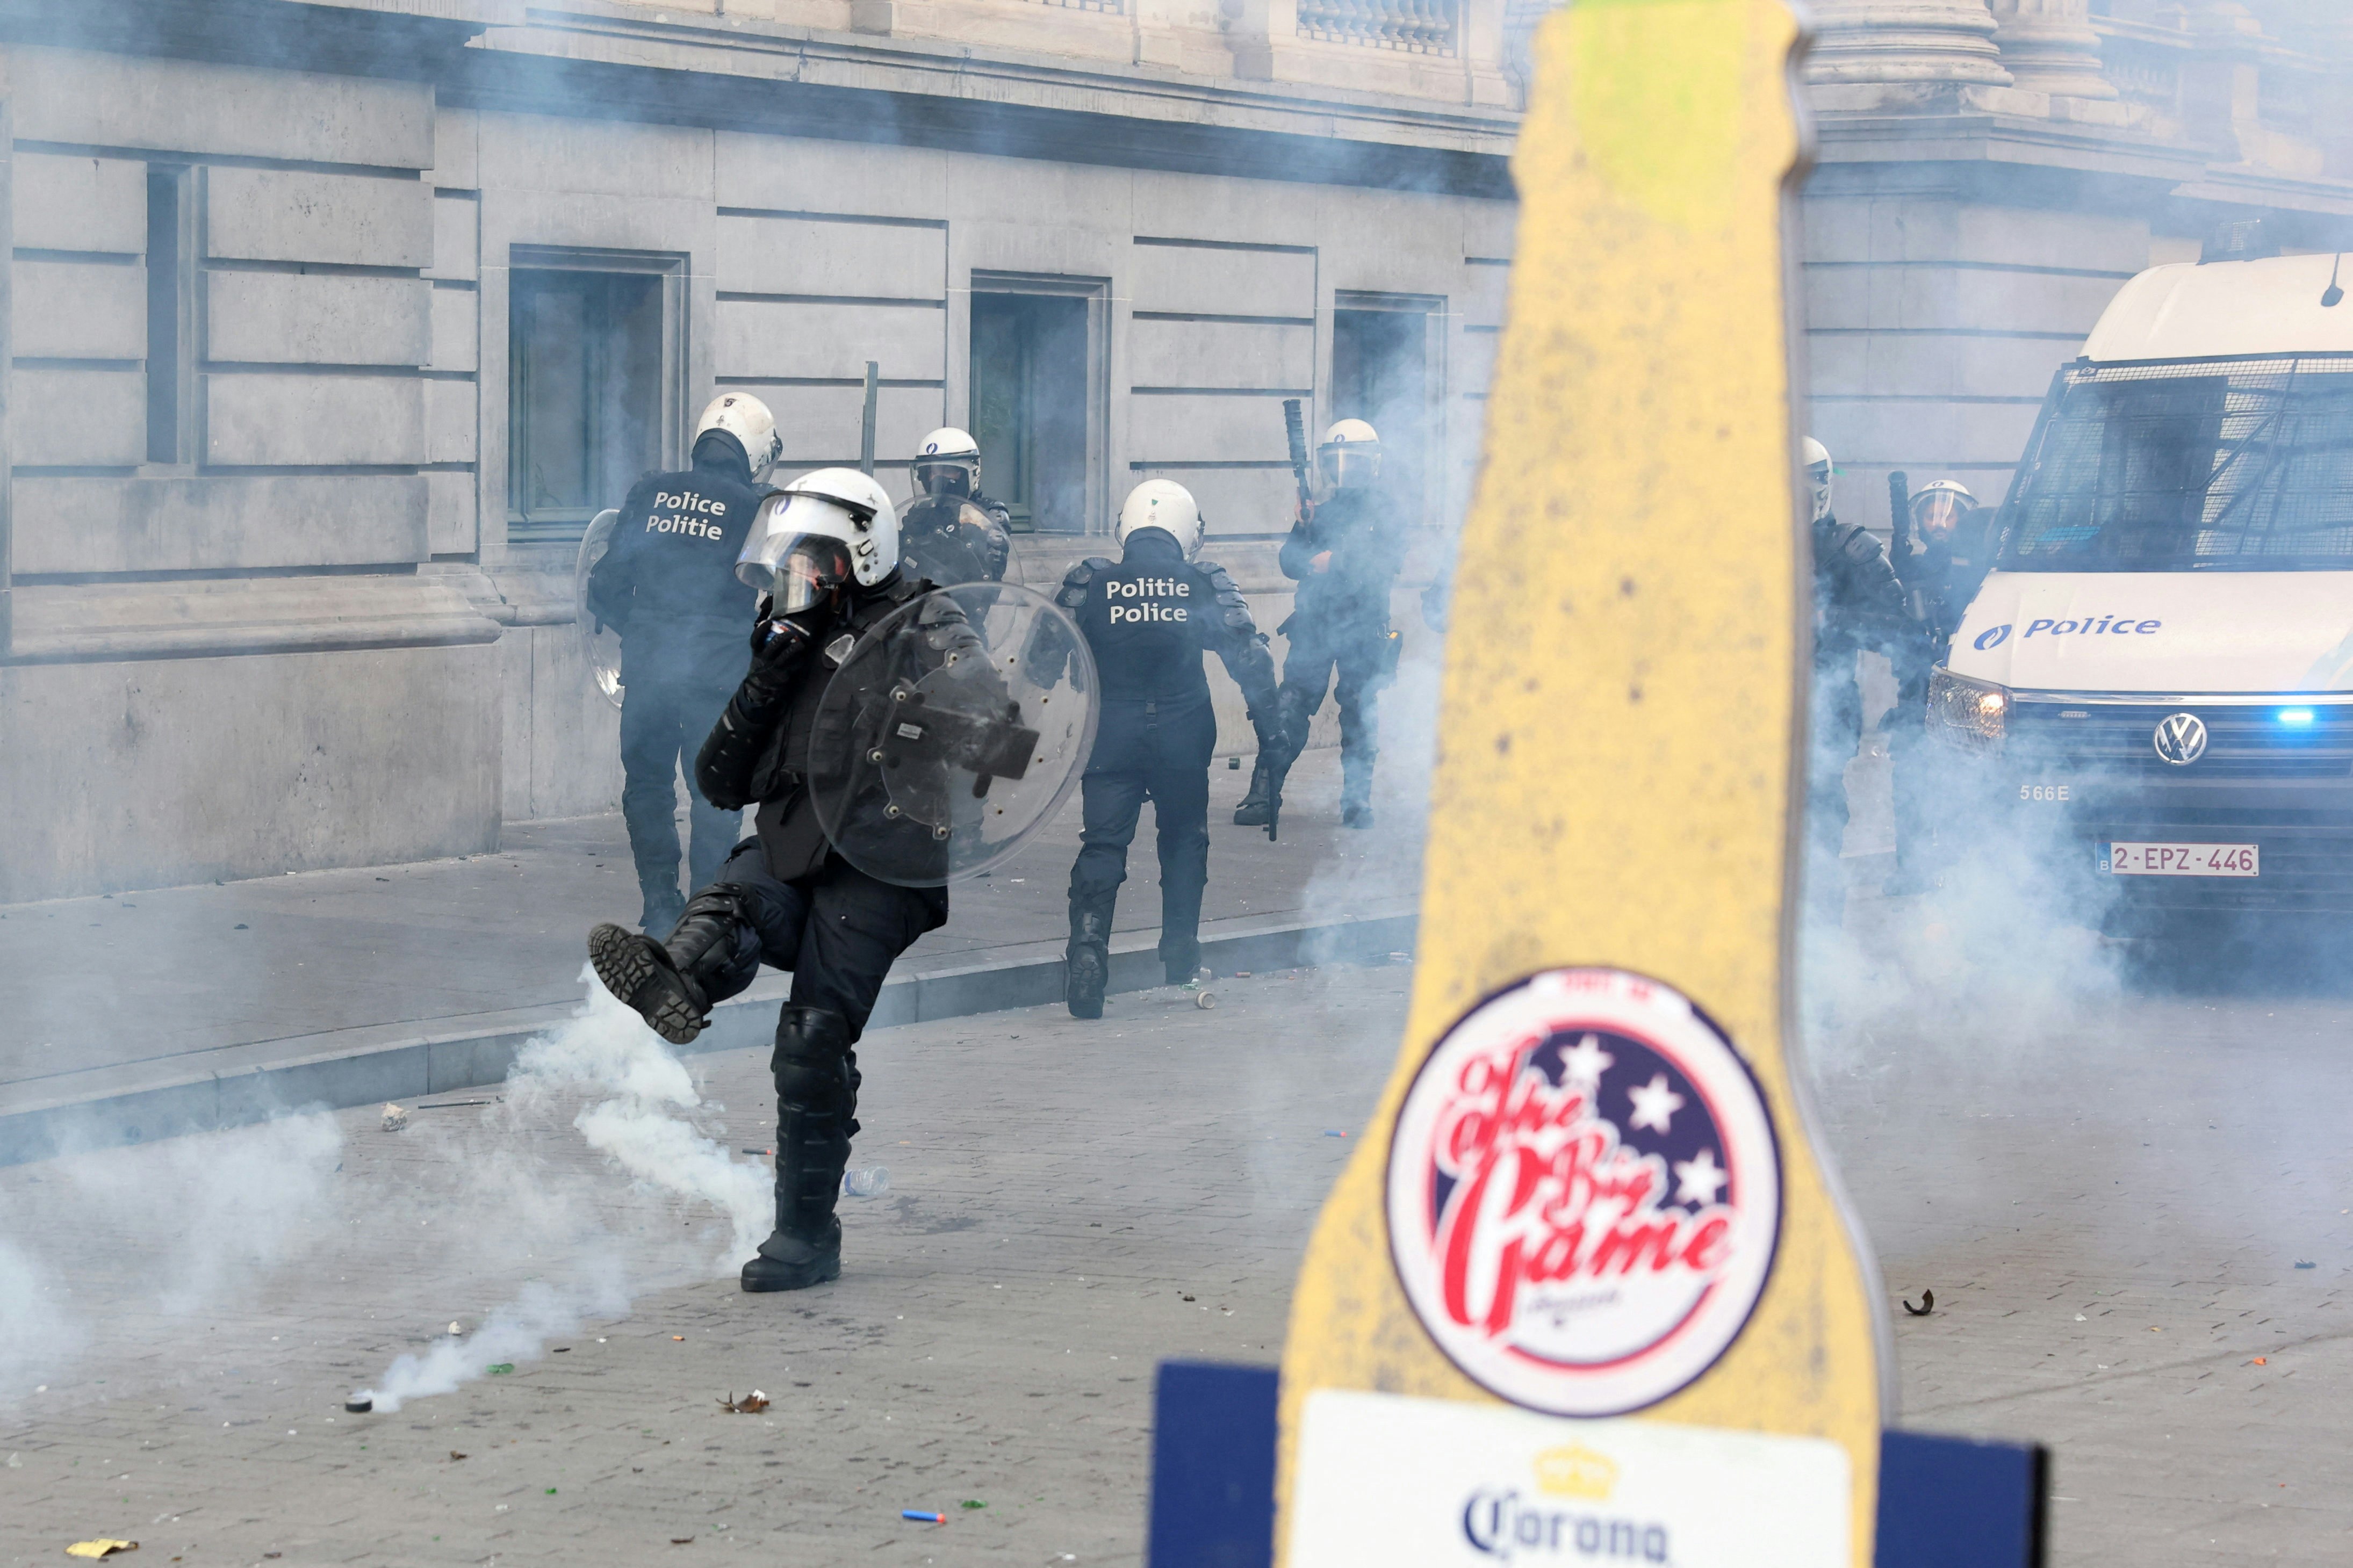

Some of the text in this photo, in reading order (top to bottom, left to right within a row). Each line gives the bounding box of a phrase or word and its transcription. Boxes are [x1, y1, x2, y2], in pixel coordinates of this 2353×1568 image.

[653, 492, 725, 516] Police
[645, 515, 722, 540] Politie
[1106, 577, 1190, 599] Politie
[1110, 602, 1188, 624] Police
[2024, 615, 2162, 638] Police
[2020, 785, 2069, 800] 566E
[2100, 860, 2109, 871] B
[2114, 847, 2253, 871] 2-EPZ-446
[1443, 1145, 1731, 1338] Game
[1463, 1487, 1669, 1564] Corona
